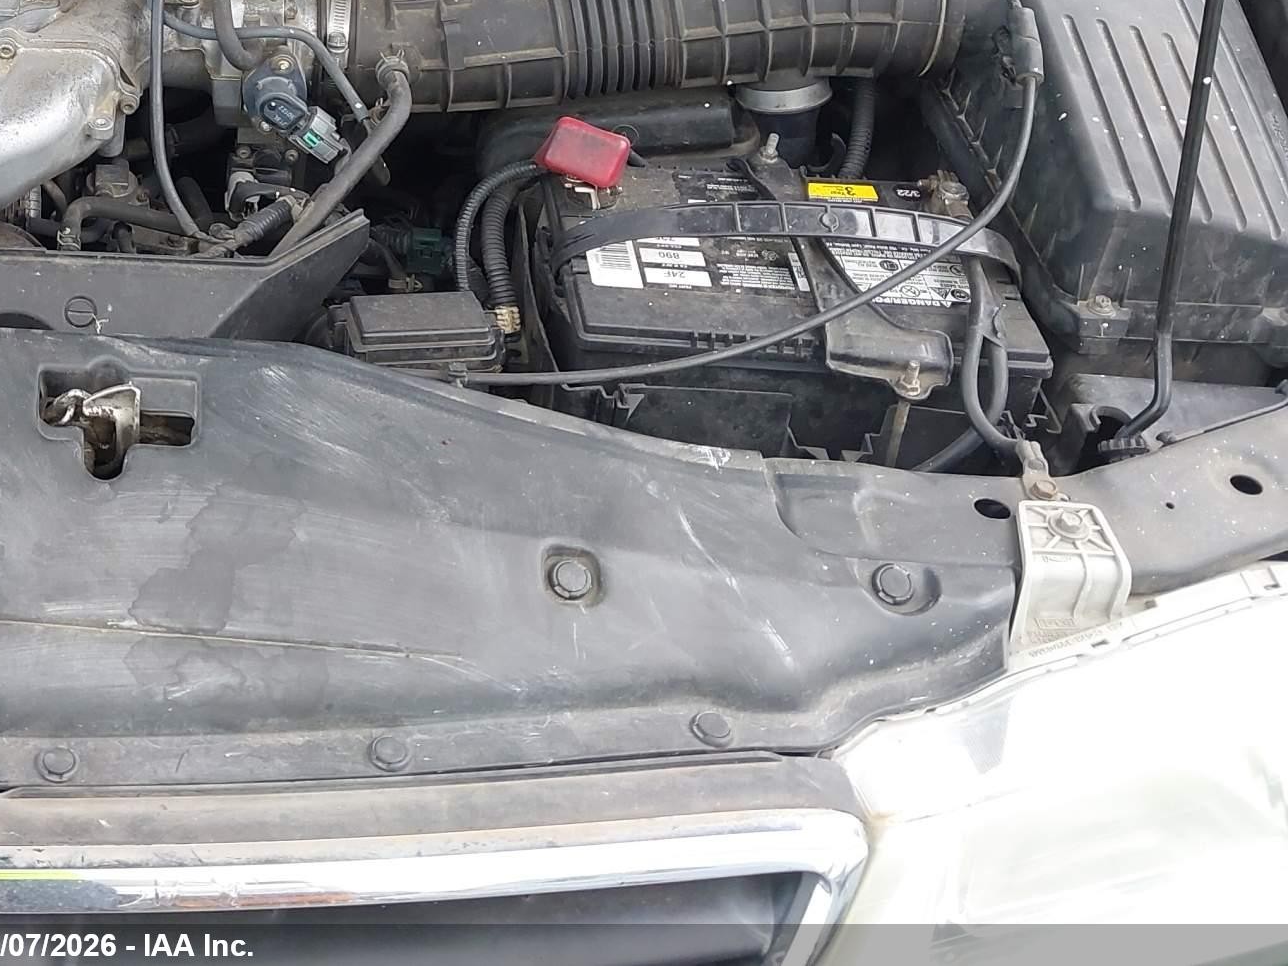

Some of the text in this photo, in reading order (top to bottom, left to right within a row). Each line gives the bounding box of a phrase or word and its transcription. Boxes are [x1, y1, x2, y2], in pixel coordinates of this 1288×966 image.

[845, 186, 856, 196] 3
[896, 188, 921, 198] 3/22
[658, 251, 680, 259] 890
[663, 271, 686, 279] 24F
[872, 296, 940, 307] DANGER/PO
